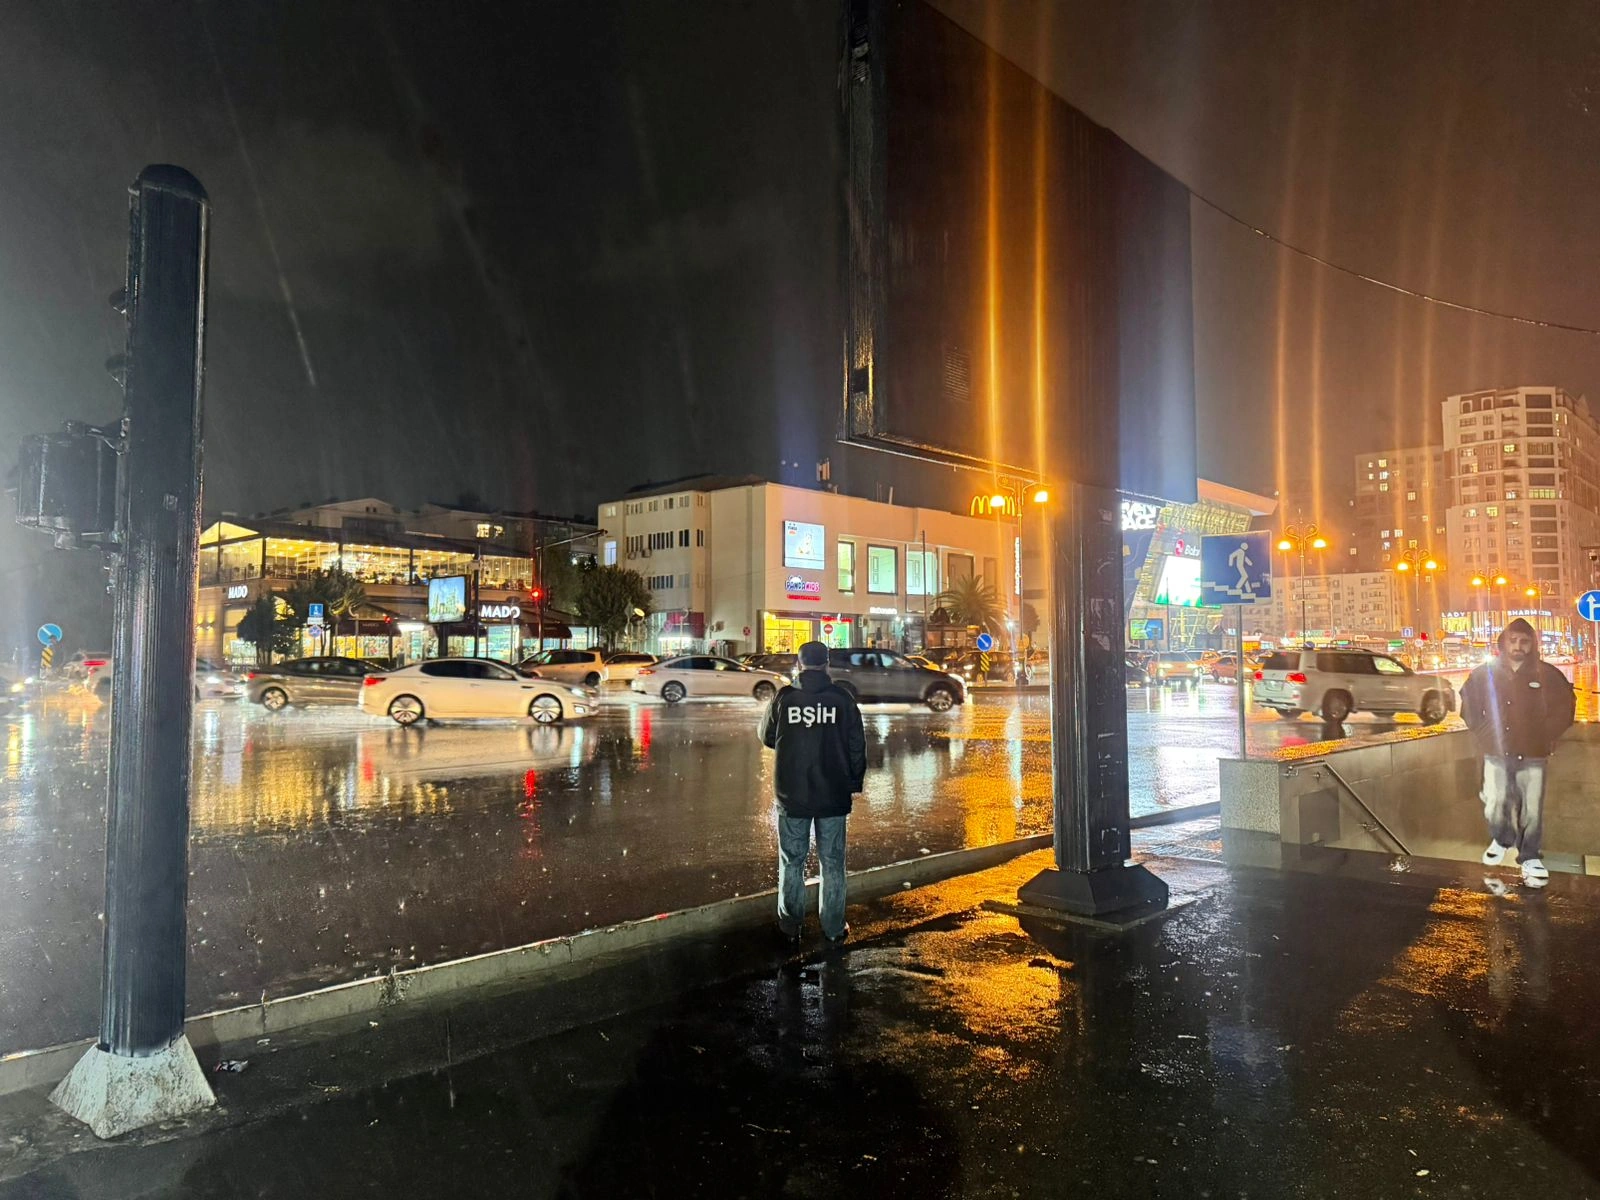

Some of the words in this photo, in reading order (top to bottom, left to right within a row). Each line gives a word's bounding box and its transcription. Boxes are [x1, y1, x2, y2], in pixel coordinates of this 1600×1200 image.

[228, 585, 248, 599] MADO
[480, 604, 520, 618] MADO
[787, 702, 837, 728] BŞİH
